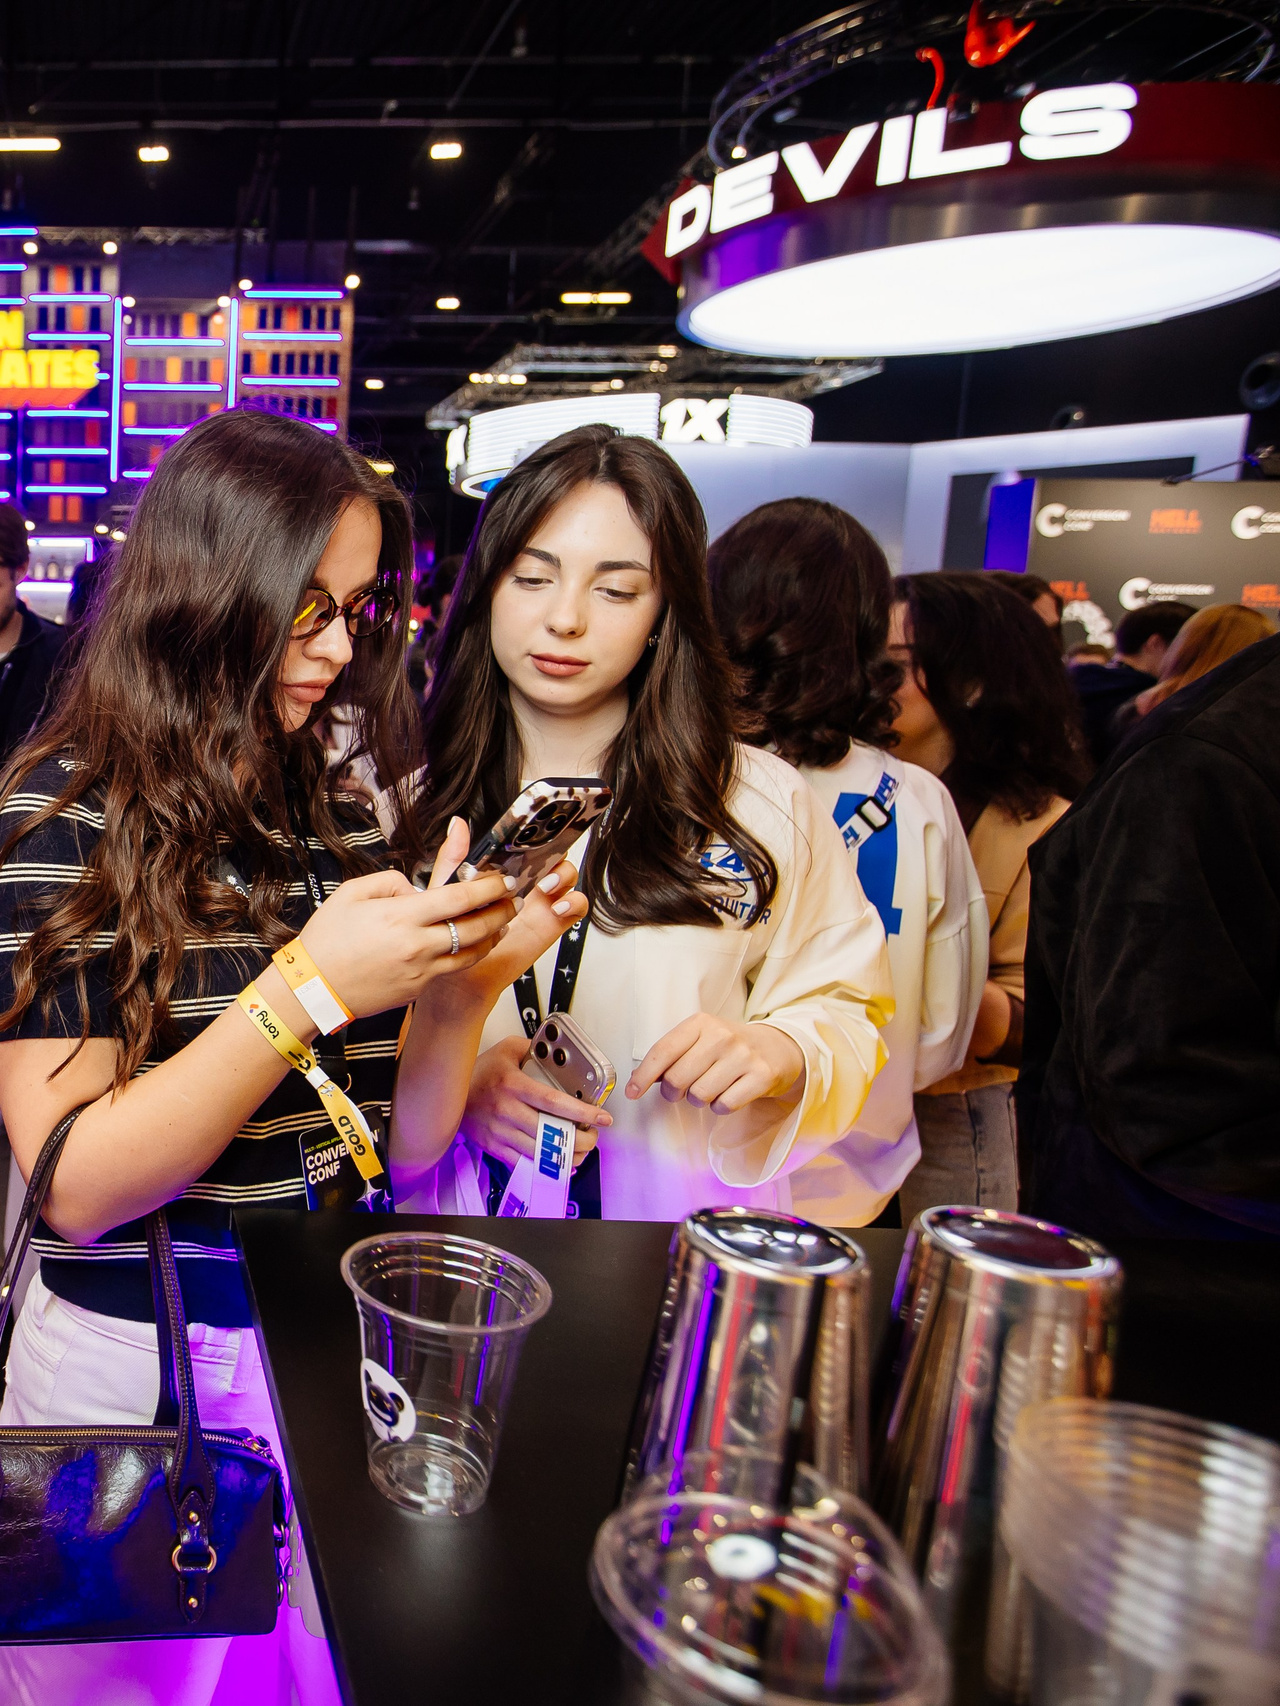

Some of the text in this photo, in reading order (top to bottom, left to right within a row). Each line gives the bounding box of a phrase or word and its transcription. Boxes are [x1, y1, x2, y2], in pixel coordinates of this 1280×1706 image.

[665, 83, 1139, 258] DEVILS
[255, 1010, 280, 1040] tony
[306, 1128, 380, 1170] CONVEN
[338, 1115, 366, 1157] GOLD
[308, 1160, 341, 1185] CONF
